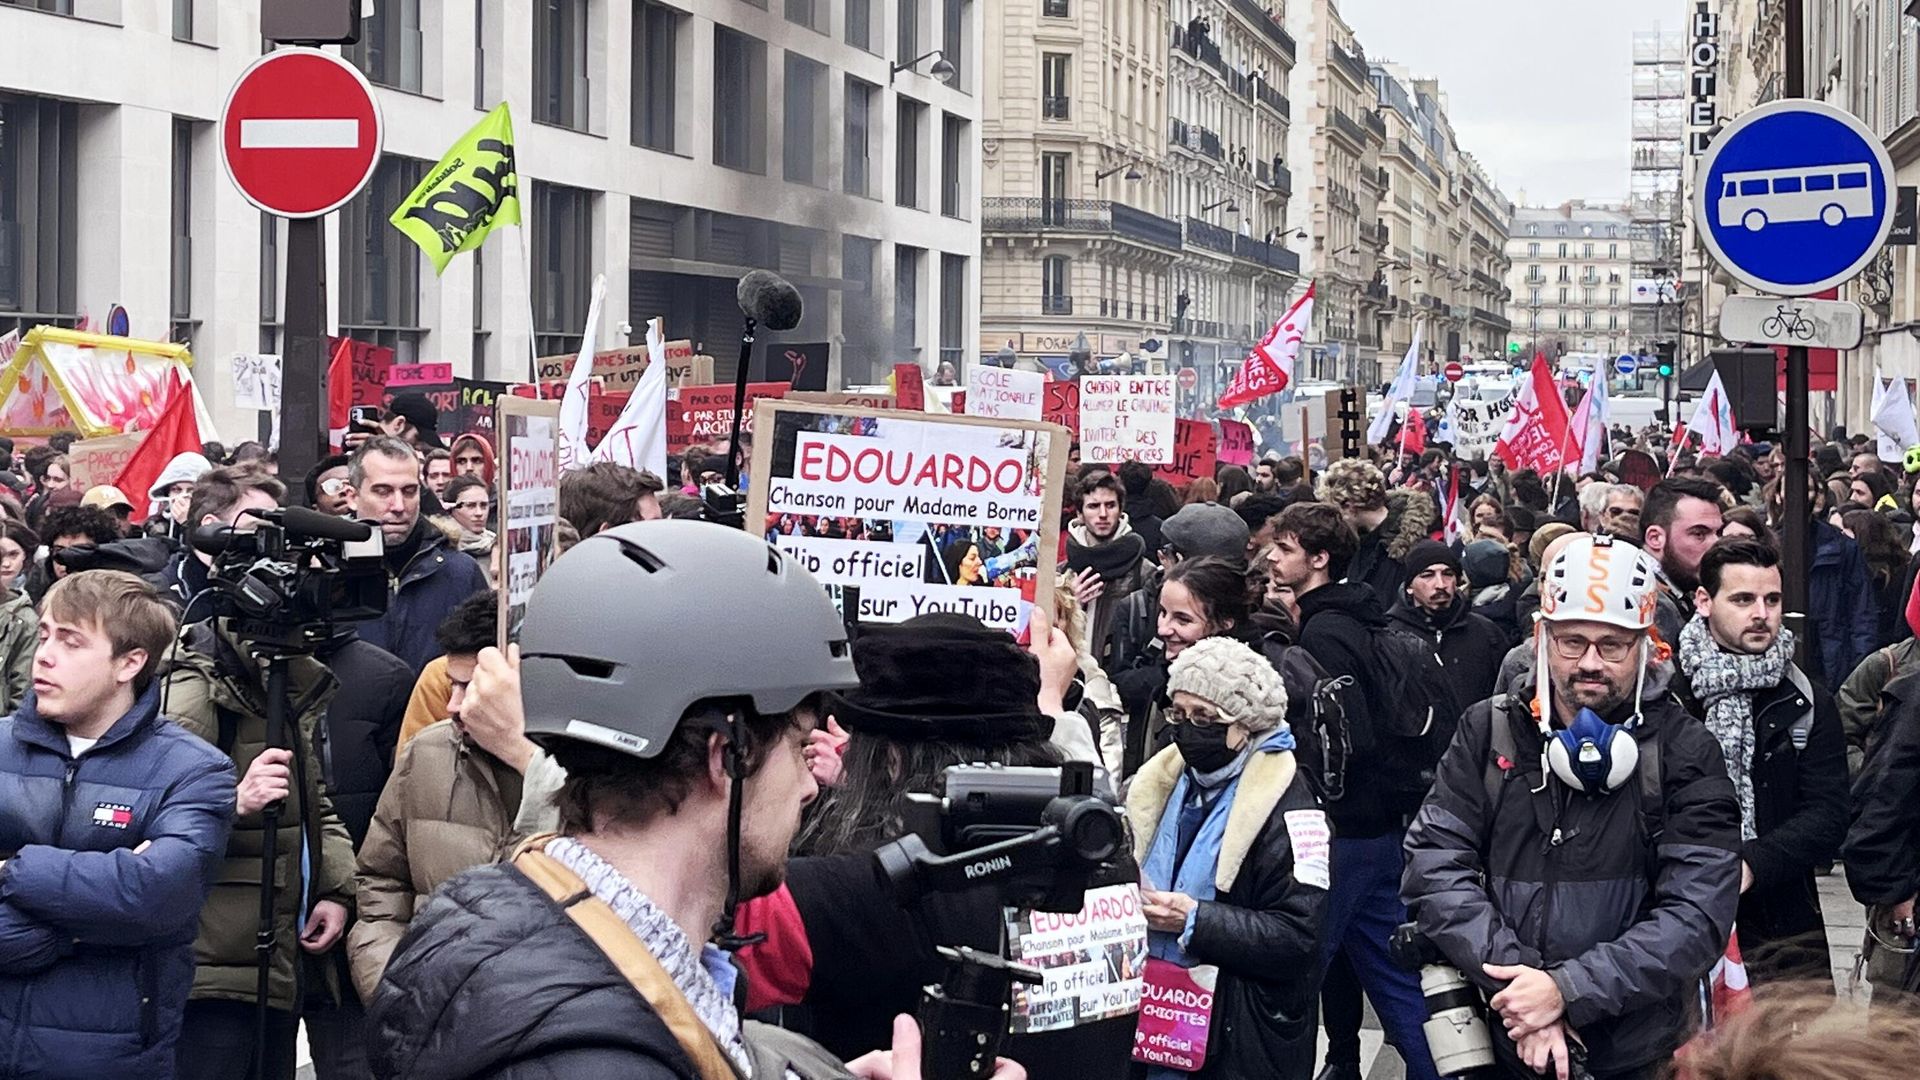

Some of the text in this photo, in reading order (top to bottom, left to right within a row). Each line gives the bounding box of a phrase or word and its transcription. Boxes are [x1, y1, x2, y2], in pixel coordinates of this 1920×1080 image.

[1693, 13, 1718, 155] HOTEL
[1085, 380, 1171, 396] CHOISIR ENTRE
[694, 410, 714, 421] PAR
[1117, 399, 1128, 412] LE
[1114, 415, 1129, 429] ET
[1136, 429, 1157, 446] DES
[800, 440, 1024, 495] EDOUARDO
[770, 486, 1038, 523] Chanson pour Madame Borne
[833, 549, 924, 581] officiel
[860, 599, 898, 618] sur
[910, 594, 1018, 624] YouTube
[964, 855, 1013, 879] RONIN
[1022, 937, 1064, 954] Chanson
[1090, 926, 1123, 941] Madame
[1064, 965, 1108, 992] officiel
[1080, 1000, 1098, 1013] sur
[1141, 981, 1214, 1010] OUARDO
[1143, 1003, 1208, 1027] CHIOTTES
[1148, 1032, 1192, 1052] officiel
[1142, 1046, 1193, 1068] YouTube
